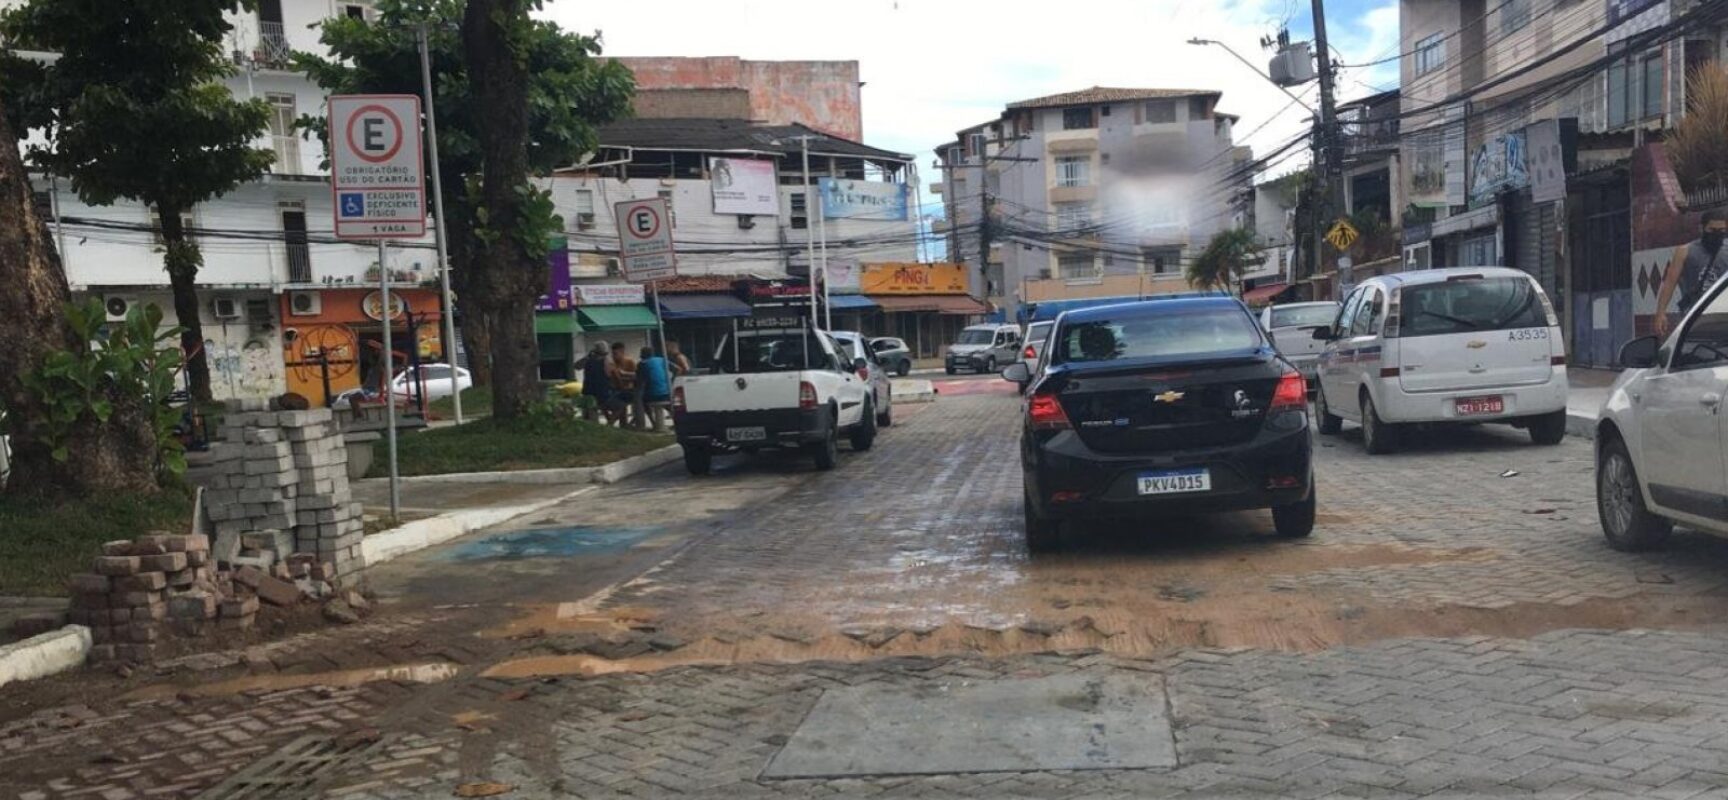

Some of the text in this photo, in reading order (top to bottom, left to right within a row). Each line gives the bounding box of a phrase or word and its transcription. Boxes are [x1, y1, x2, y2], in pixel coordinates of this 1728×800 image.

[364, 118, 385, 151] E
[345, 165, 409, 175] OBRIGATÓRIO
[340, 176, 358, 184] USO
[379, 174, 417, 183] CARTÃO
[366, 192, 416, 200] EXCLUSIVO
[636, 212, 651, 232] E
[381, 225, 407, 233] VAGA
[1508, 328, 1548, 341] A3535
[1144, 475, 1204, 493] PKV4D15
